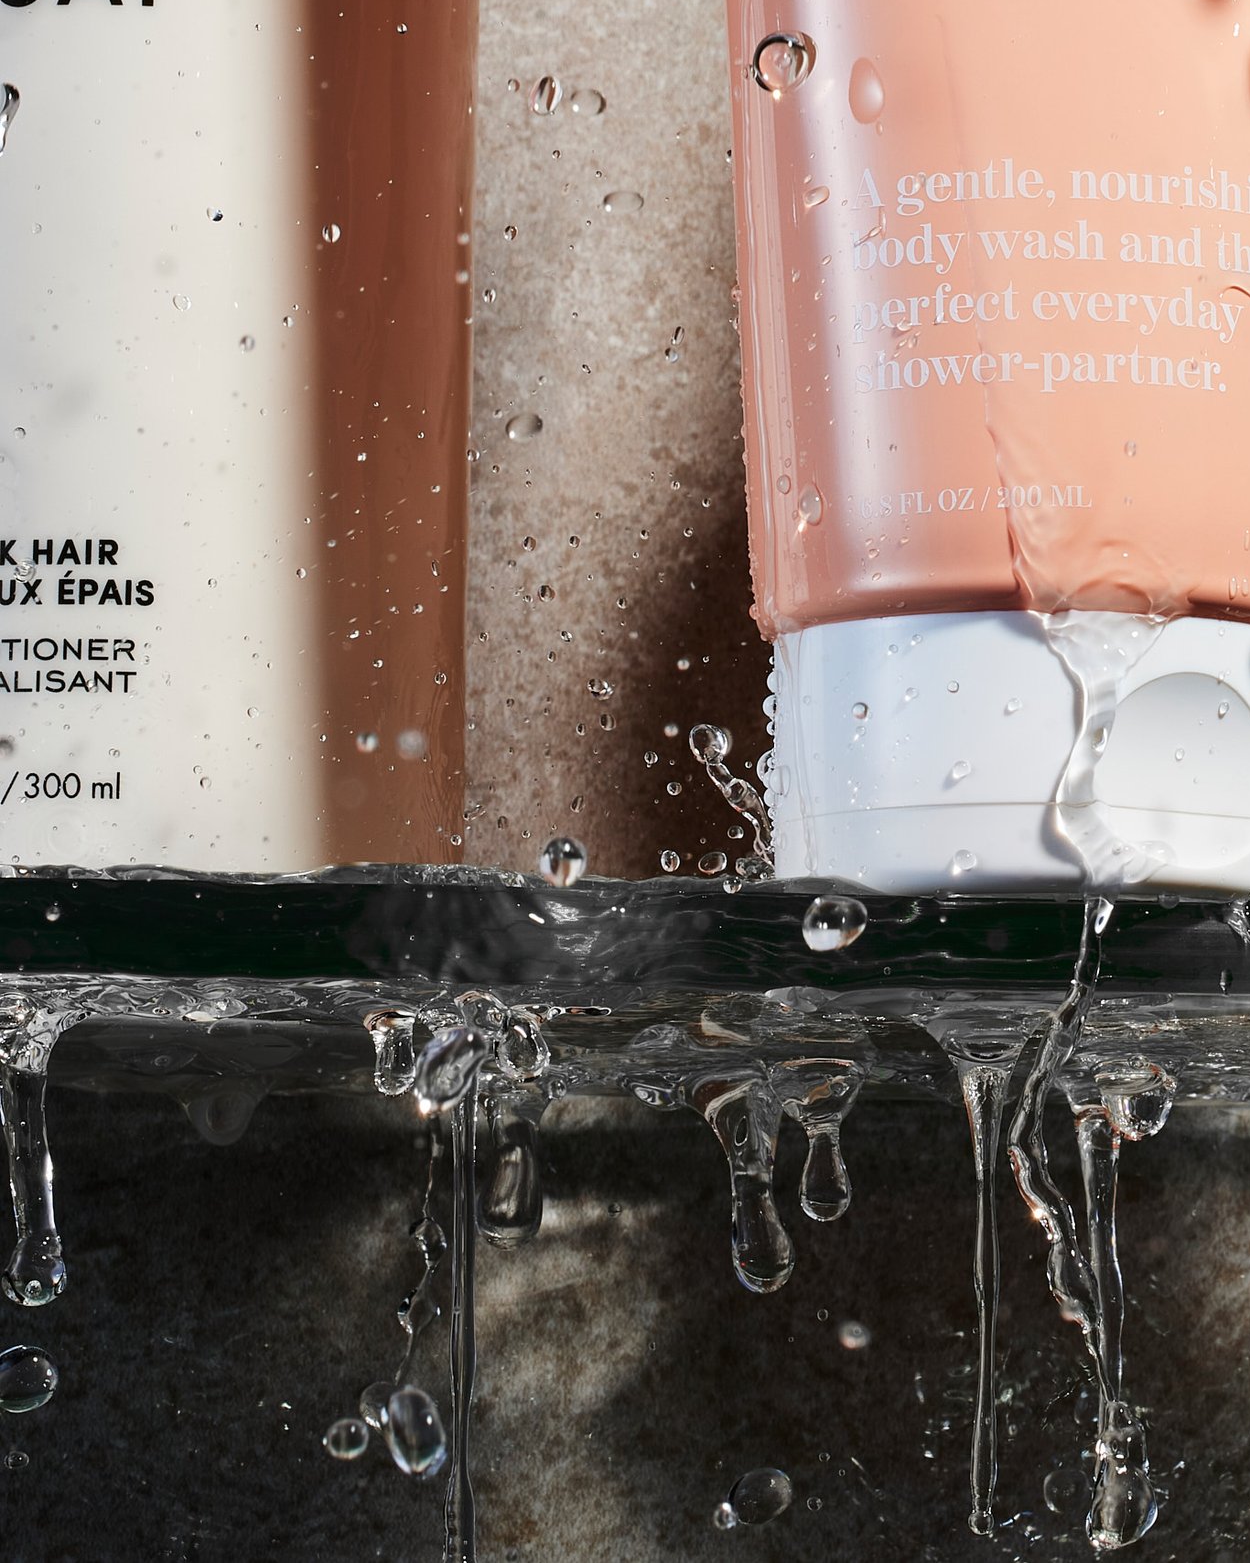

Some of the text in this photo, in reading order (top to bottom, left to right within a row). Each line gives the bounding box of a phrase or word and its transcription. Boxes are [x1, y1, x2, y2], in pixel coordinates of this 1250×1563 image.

[851, 167, 885, 210] A
[896, 158, 1056, 216] gentle,
[851, 223, 964, 274] body
[978, 220, 1106, 260] wash
[1120, 227, 1205, 268] and
[852, 279, 1244, 344] perfect everyday
[855, 342, 1227, 394] shower-partner.
[860, 484, 1093, 519] 6.8 FL OZ / 200 ML
[33, 539, 119, 565] HAIR
[0, 570, 155, 606] UX ÉPAIS
[1, 638, 136, 661] TIONER
[92, 772, 120, 800] ml
